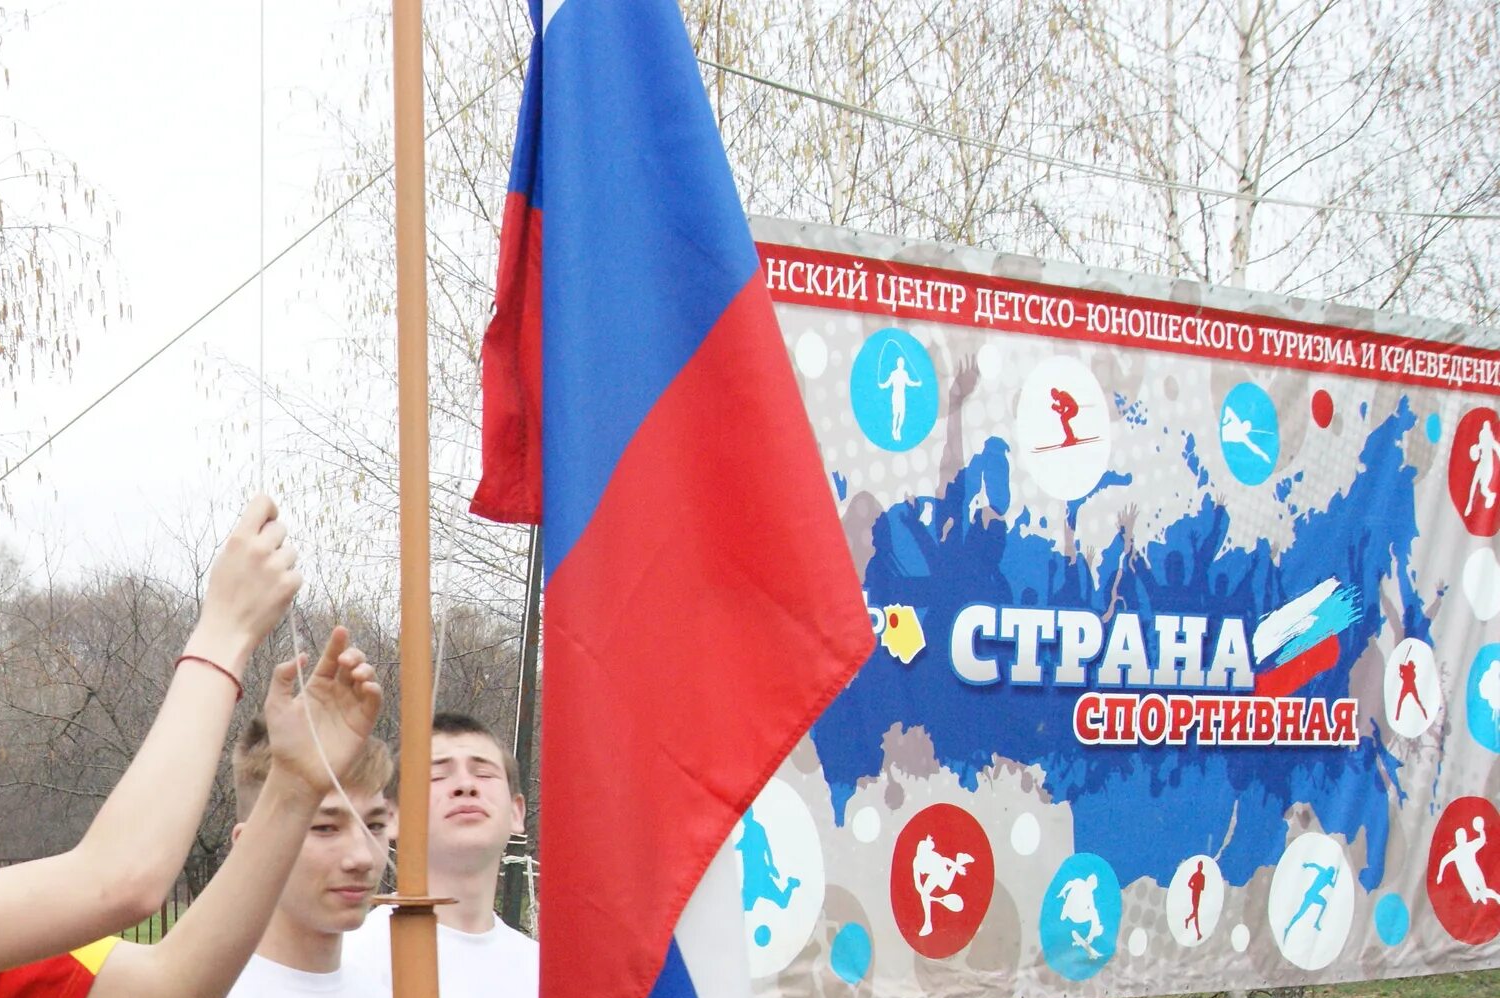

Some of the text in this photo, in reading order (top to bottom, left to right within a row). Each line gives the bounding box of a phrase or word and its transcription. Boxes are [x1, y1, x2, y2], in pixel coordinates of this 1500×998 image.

[766, 258, 1500, 387] НСКИЙ ЦЕНТР ДЕТСКО-ЮНОШЕСКОГО ТУРИЗМА И КРАЕВЕДЕНИ
[950, 604, 1255, 688] СТРАНА
[1073, 693, 1359, 746] СПОРТИВНАЯ
